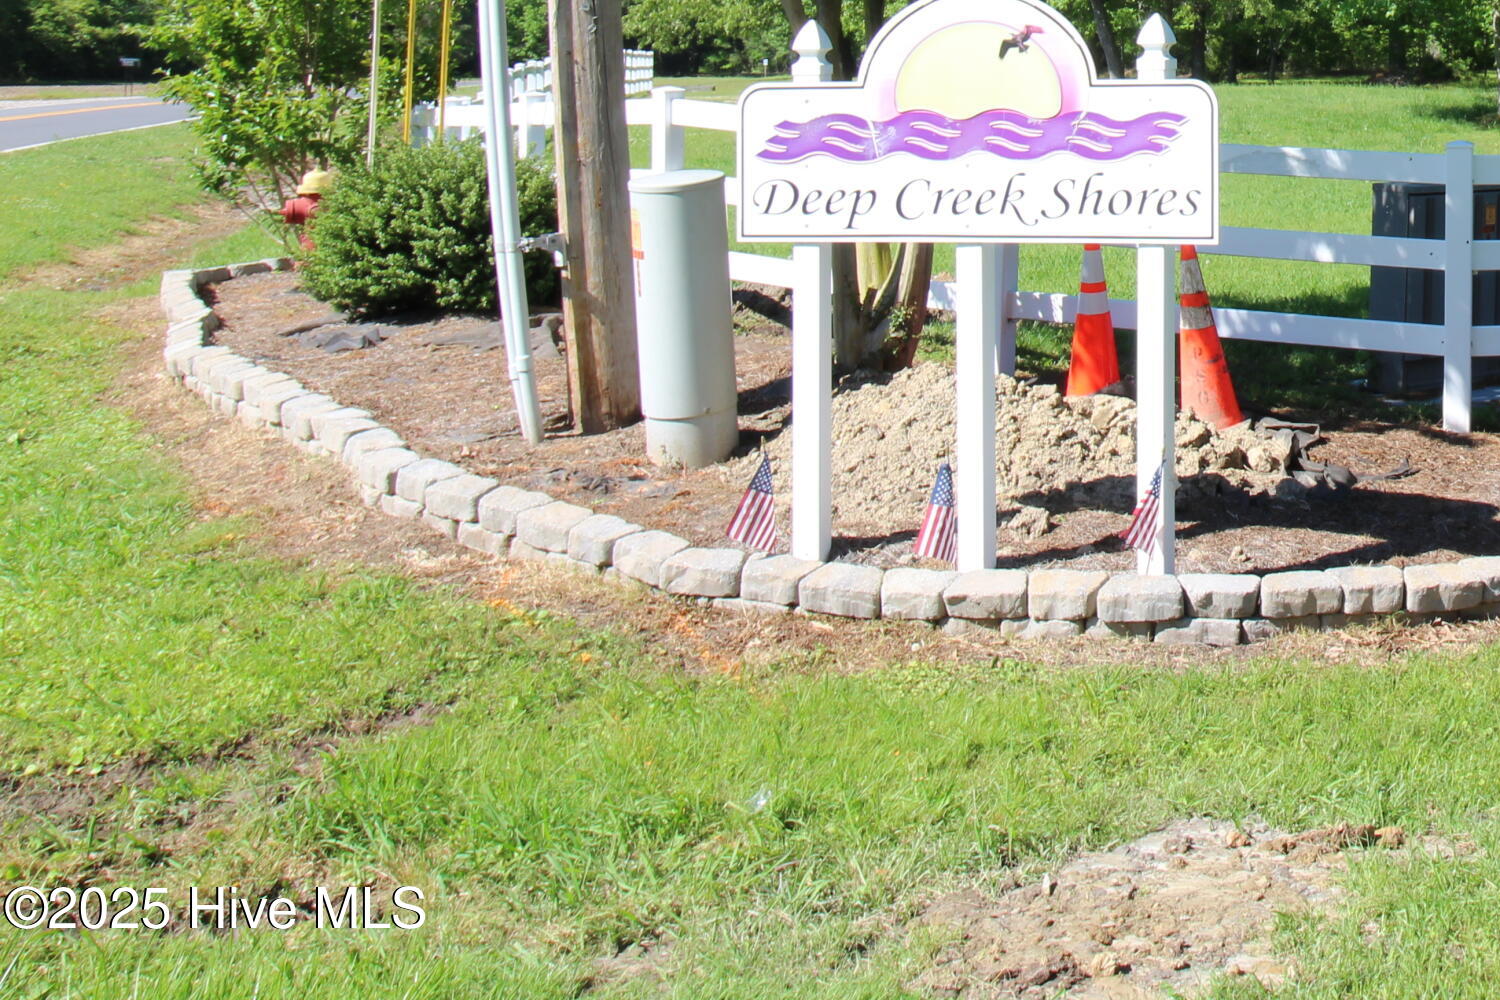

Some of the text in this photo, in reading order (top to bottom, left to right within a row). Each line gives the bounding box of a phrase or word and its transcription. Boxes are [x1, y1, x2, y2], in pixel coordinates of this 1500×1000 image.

[753, 173, 1202, 230] Deep Creek Shores
